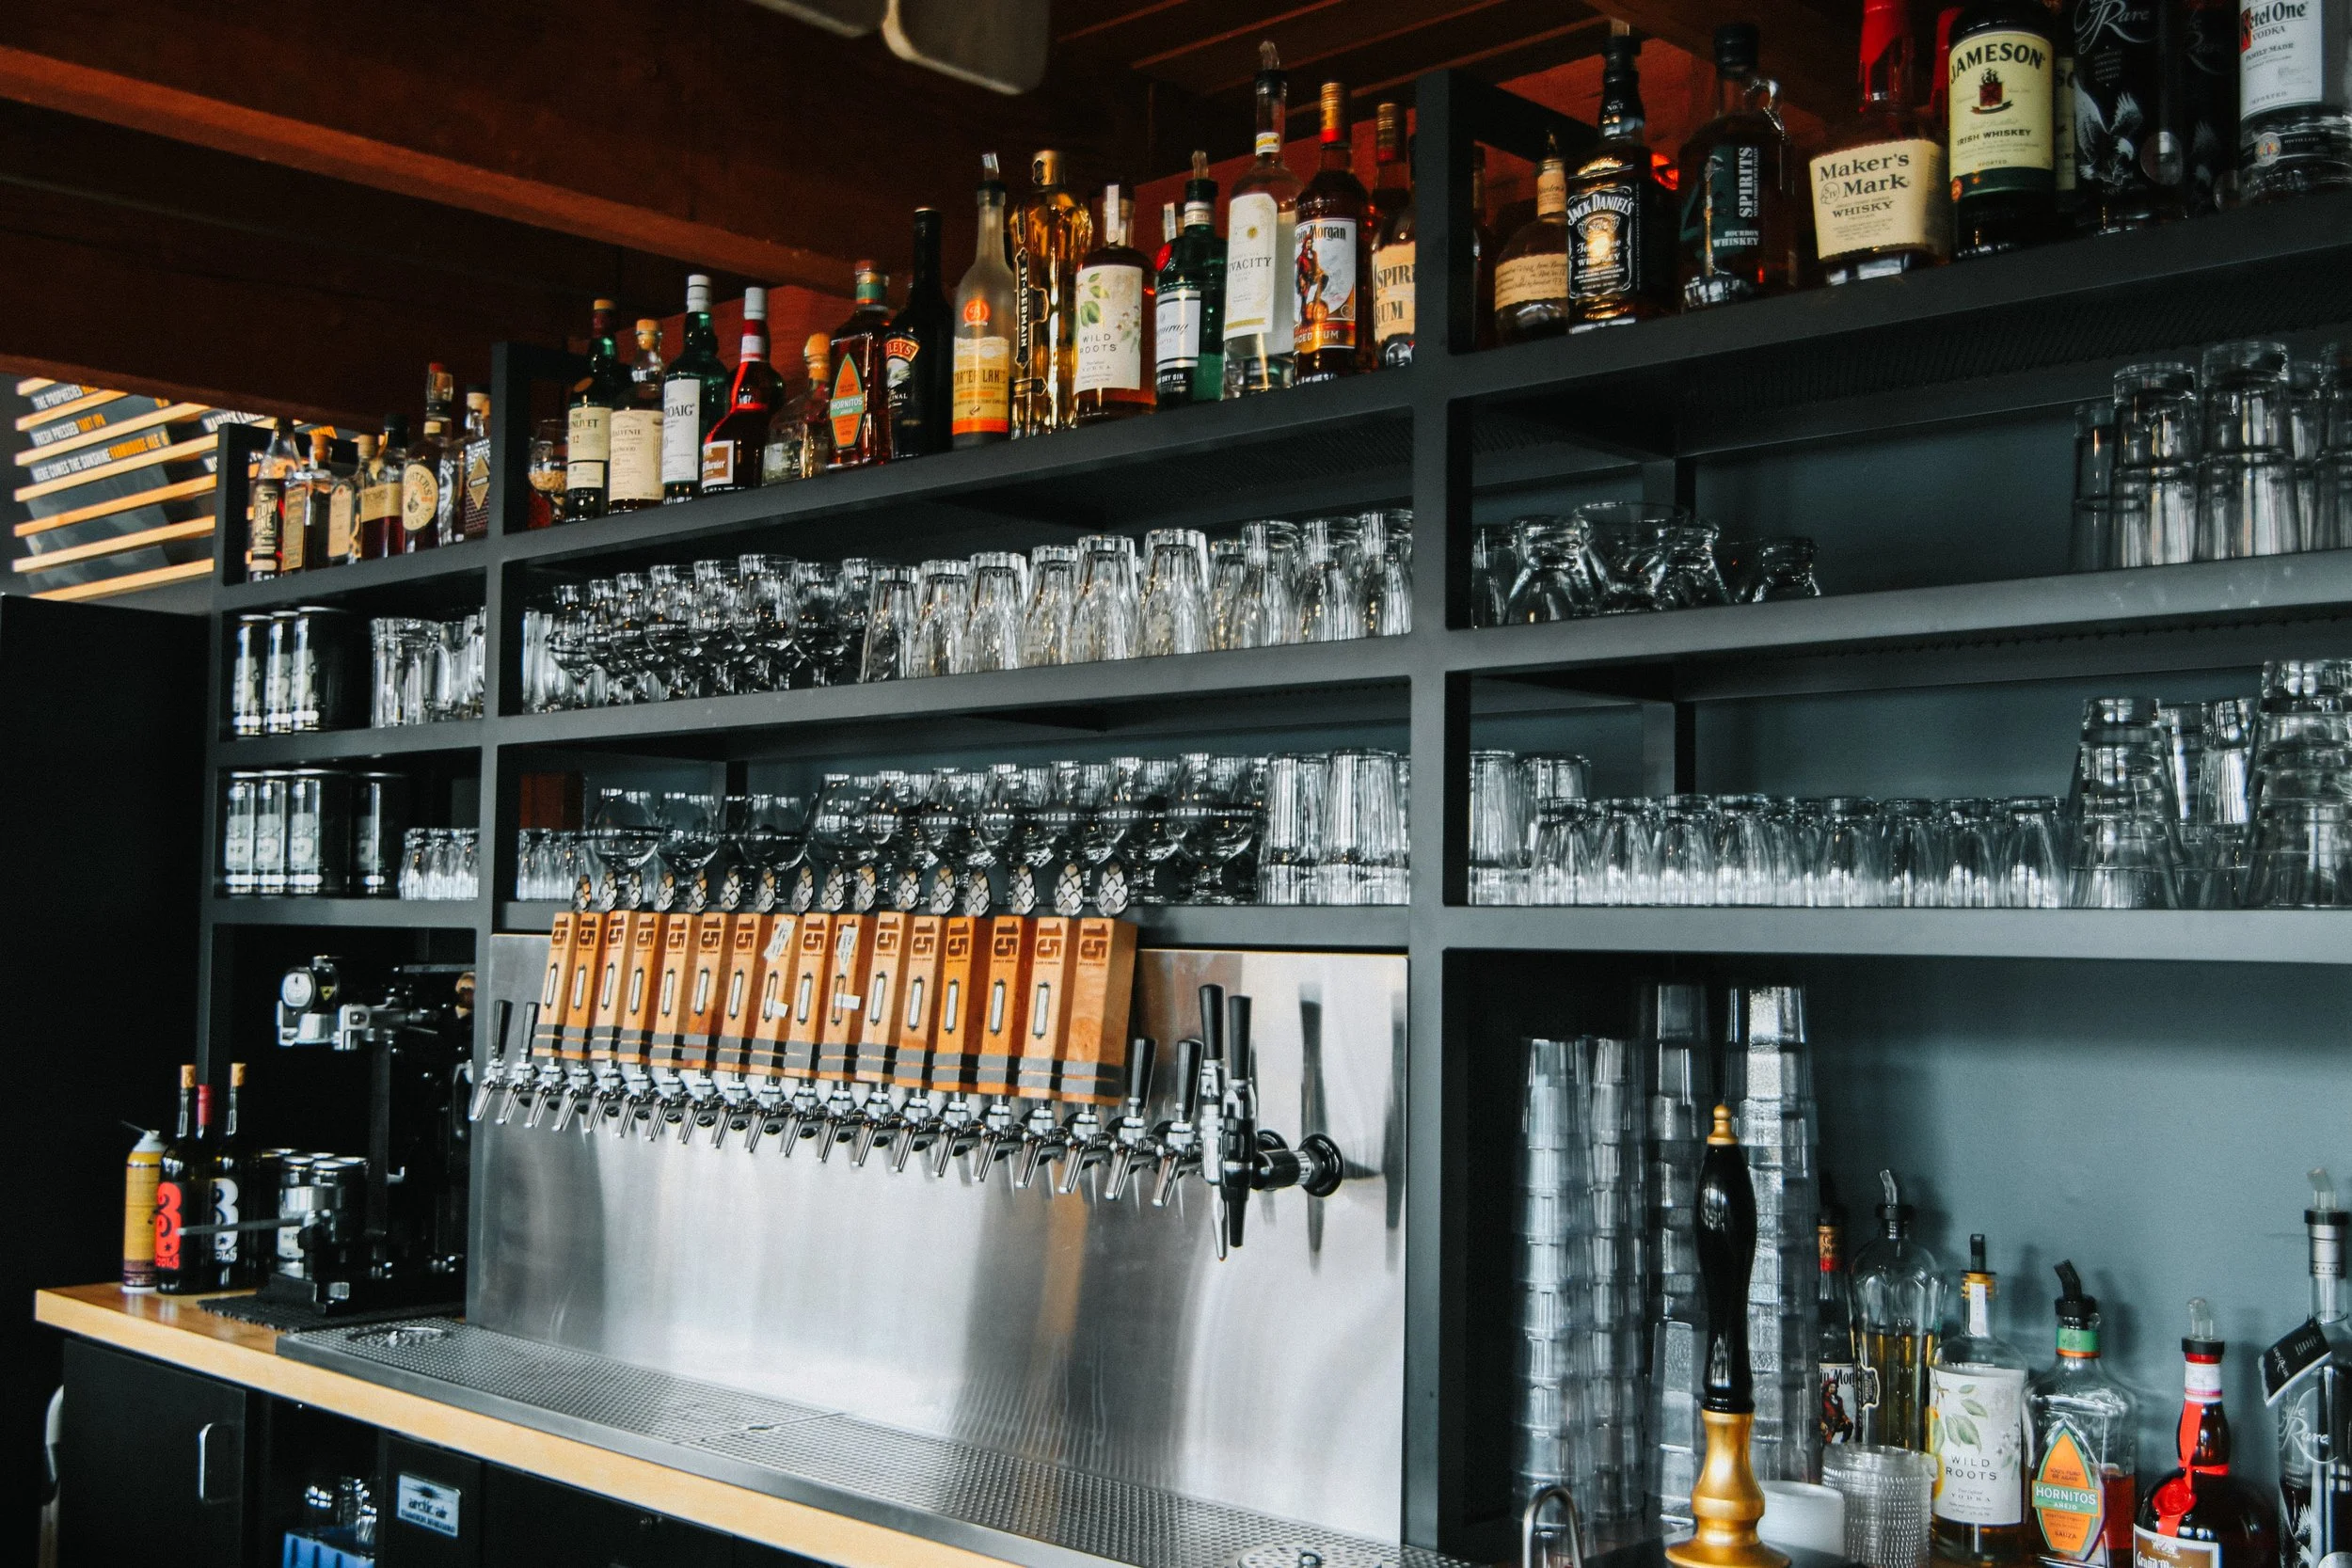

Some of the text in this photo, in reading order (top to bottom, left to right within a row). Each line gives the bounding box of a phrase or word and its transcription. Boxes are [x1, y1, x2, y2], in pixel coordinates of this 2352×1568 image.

[2273, 2, 2306, 22] One
[2252, 25, 2286, 40] VODKA
[1950, 42, 2043, 85] JAMESON
[1983, 128, 2031, 139] WHISKEY
[1739, 147, 1754, 218] SPIRITS
[1820, 153, 1910, 182] Maker's
[1844, 173, 1909, 198] Mark
[1567, 199, 1593, 226] JACK
[1592, 194, 1635, 215] DANIEL'S
[1833, 200, 1894, 218] WHISKY
[1309, 224, 1346, 242] Morgan
[1712, 237, 1759, 248] WHISKEY
[1019, 266, 1028, 348] ST-GERMAIN
[1083, 333, 1111, 343] WILD
[832, 396, 863, 411] HORNITOS
[552, 917, 568, 945] 15
[580, 917, 596, 945] 15
[608, 914, 625, 944] 15
[637, 917, 655, 947] 15
[668, 918, 687, 948] 15
[701, 917, 722, 948] 15
[736, 918, 755, 949] 15
[803, 918, 826, 951] 15
[877, 917, 899, 951] 15
[913, 922, 936, 956] 15
[947, 922, 970, 957] 15
[994, 921, 1018, 957] 15
[1036, 923, 1063, 958] 15
[1081, 923, 1108, 959] 15
[1946, 1467, 1997, 1481] ROOTS
[1951, 1455, 1991, 1467] WILD
[2036, 1486, 2097, 1506] HORNITOS
